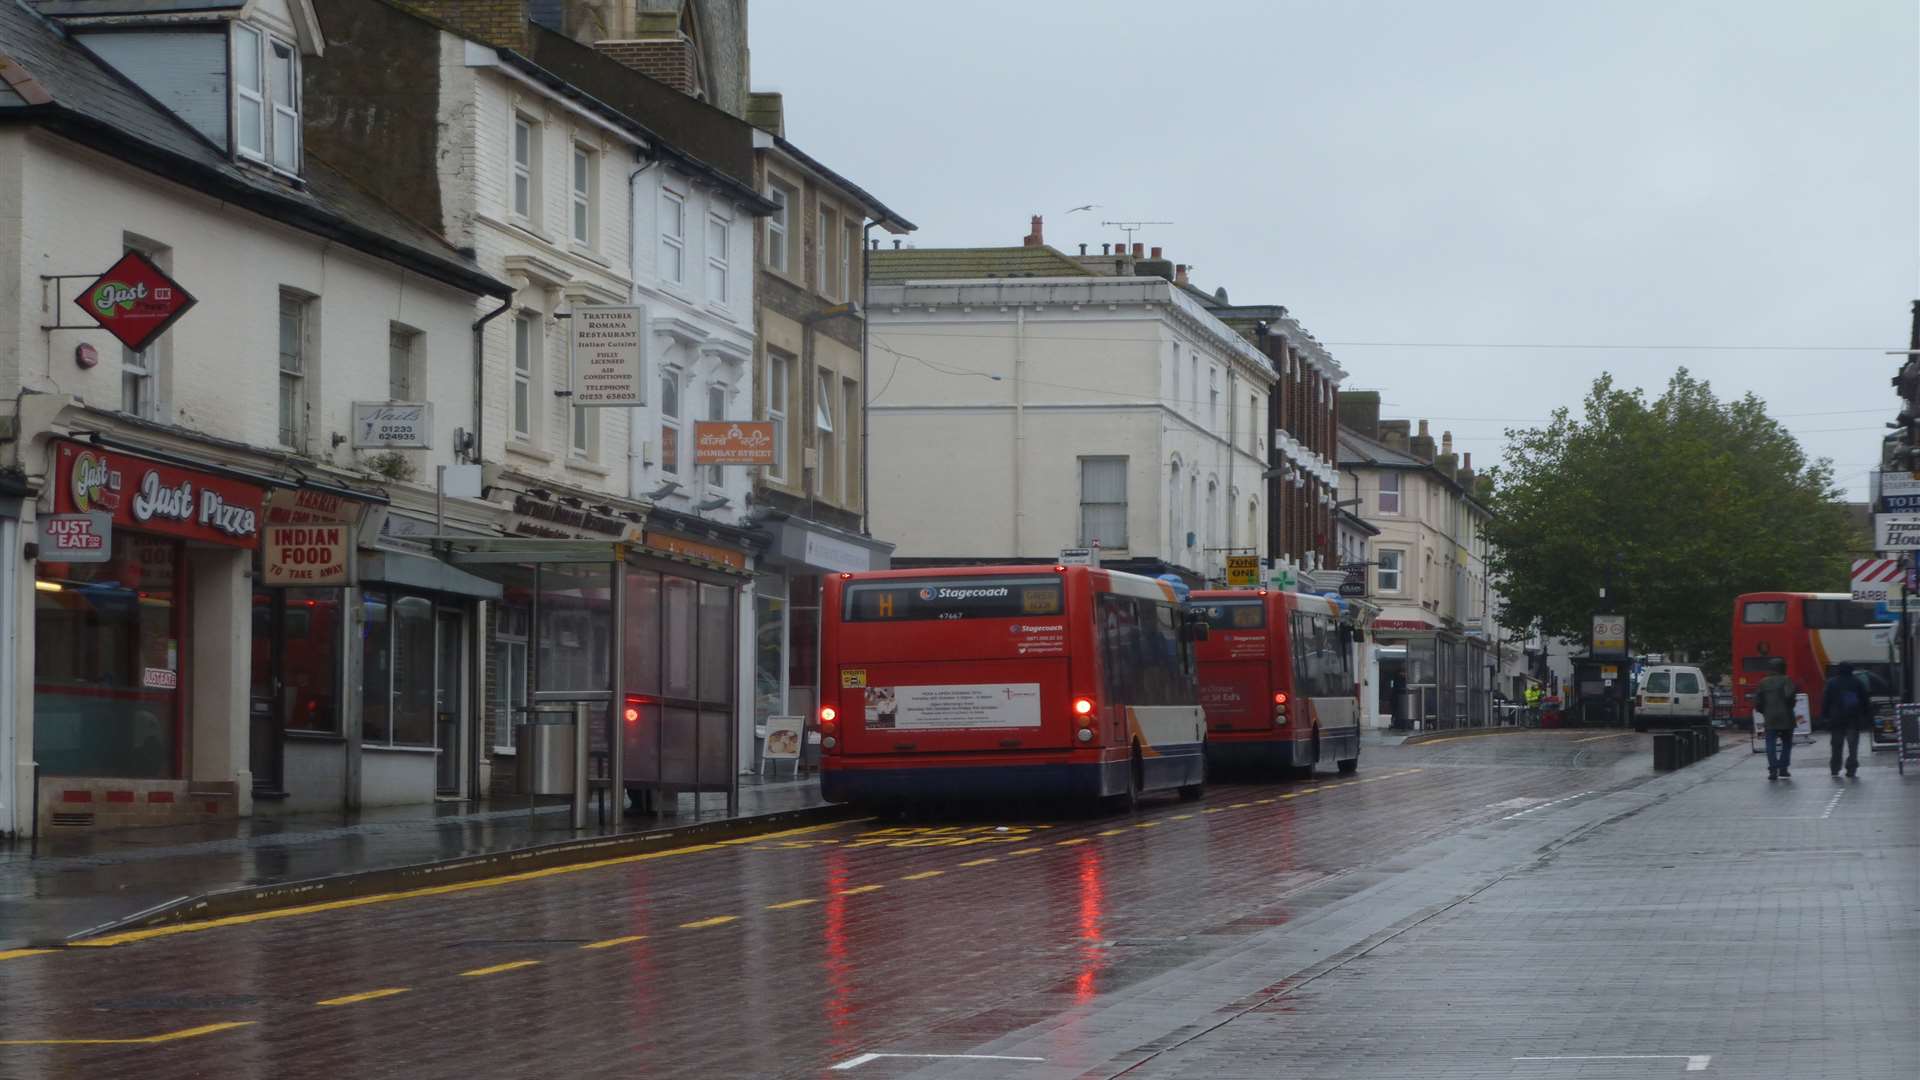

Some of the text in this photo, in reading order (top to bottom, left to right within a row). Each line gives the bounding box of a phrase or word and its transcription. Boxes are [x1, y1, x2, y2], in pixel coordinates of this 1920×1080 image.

[98, 282, 148, 309] Just
[381, 425, 412, 433] 01233
[697, 449, 771, 457] BOMBAY STREET
[78, 457, 108, 496] Just
[133, 469, 193, 521] Just
[198, 487, 256, 537] Pizza
[1887, 497, 1906, 507] TO
[48, 520, 91, 536] JUST
[58, 536, 90, 549] EAT
[274, 528, 339, 546] INDIAN
[281, 547, 332, 565] FOOD
[1229, 559, 1258, 568] ZONE
[271, 564, 343, 579] TO TAKE AWAY
[1232, 569, 1254, 577] ONE
[939, 588, 1008, 600] Stagecoach
[1852, 590, 1888, 601] BARBE
[880, 591, 893, 617] H
[1022, 625, 1063, 633] Stagecoach
[751, 835, 1030, 850] STOP
